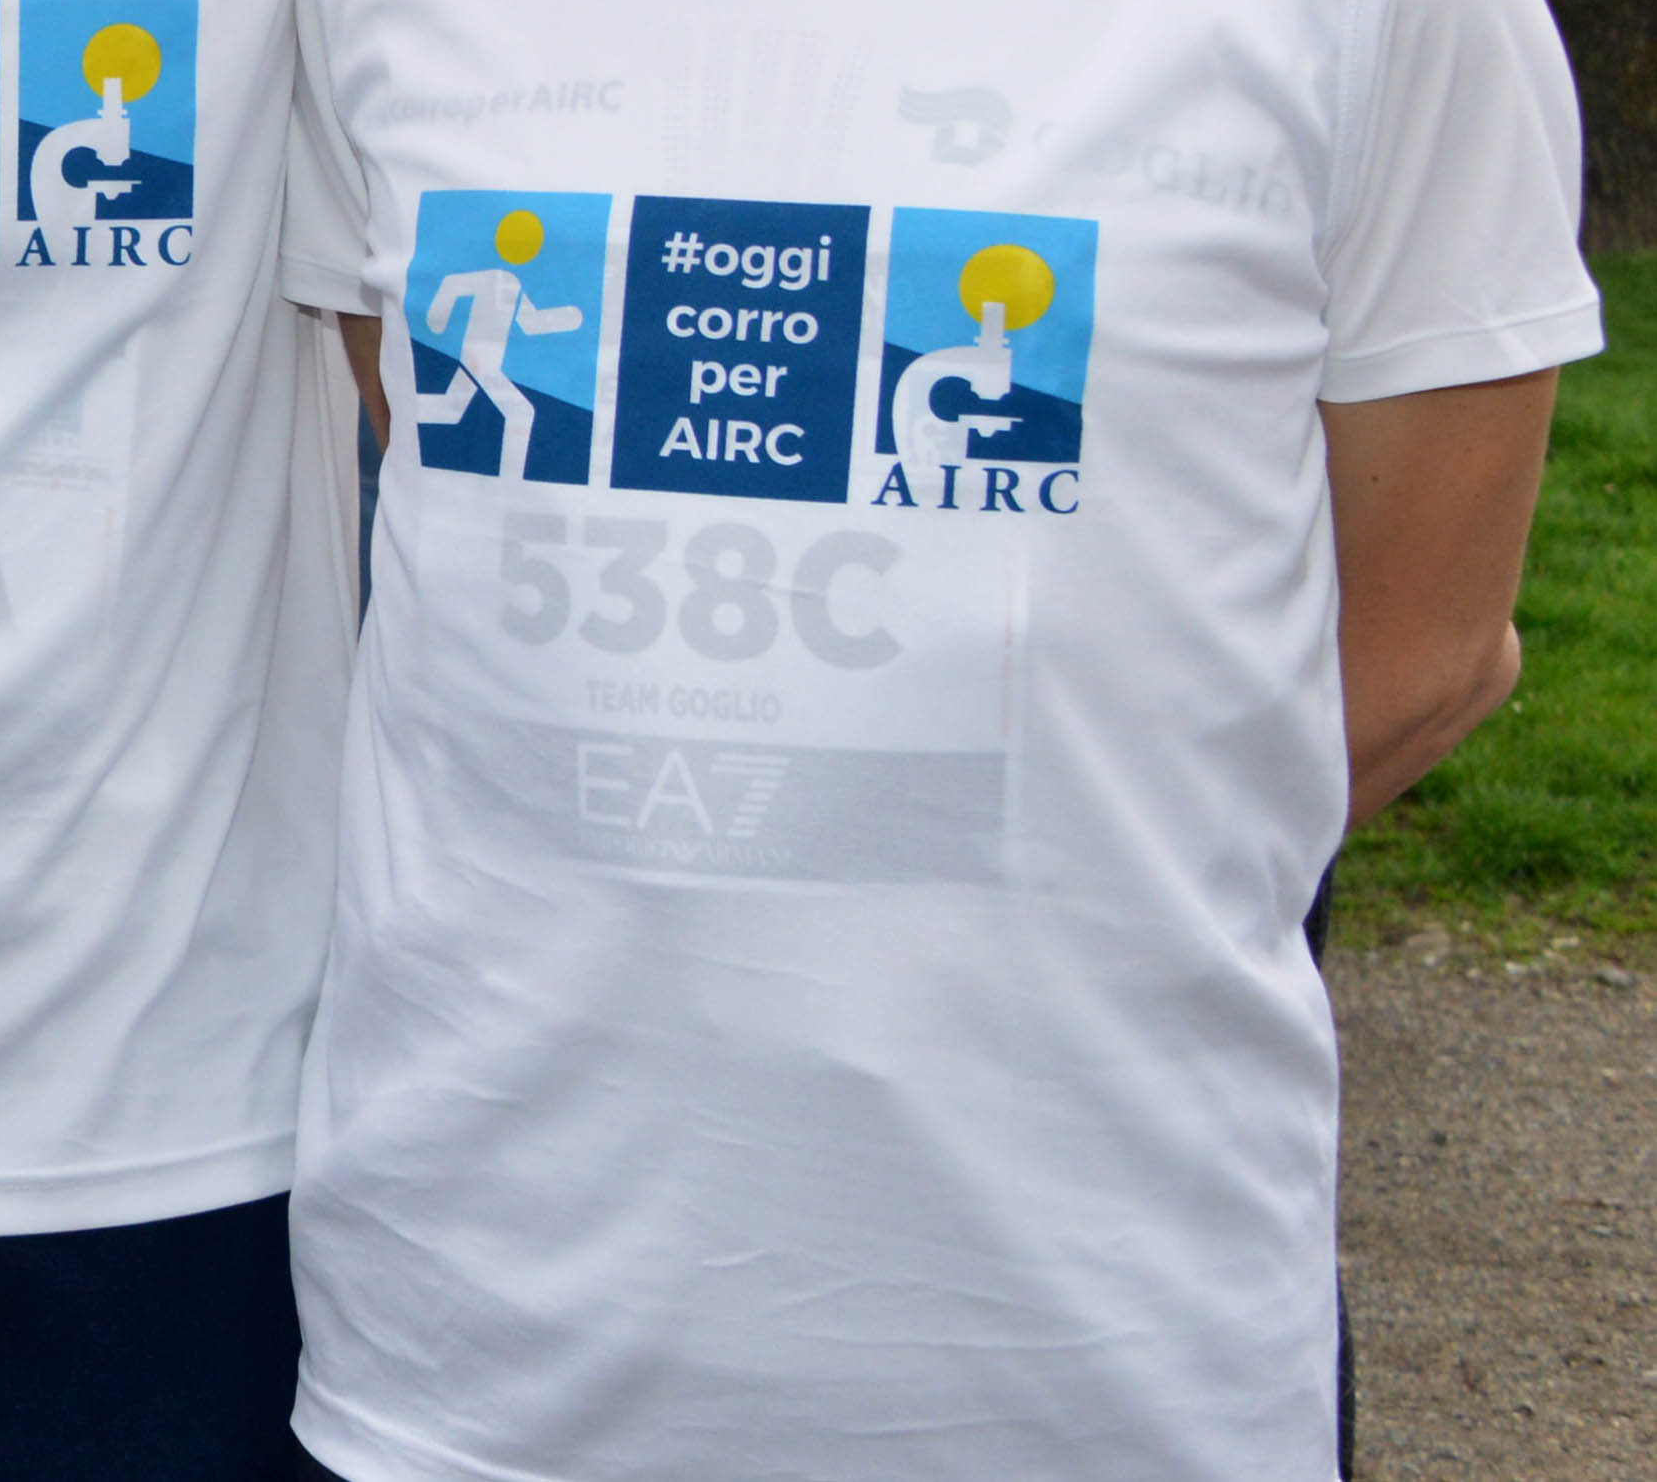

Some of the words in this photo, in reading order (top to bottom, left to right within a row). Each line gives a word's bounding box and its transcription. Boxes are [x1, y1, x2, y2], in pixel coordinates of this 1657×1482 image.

[16, 224, 194, 267] AIRC
[661, 231, 831, 291] #oggi
[666, 304, 819, 345] corro
[689, 359, 788, 405] per
[659, 416, 805, 467] AIRC
[872, 463, 1081, 514] AIRC
[499, 512, 904, 670] 538C
[585, 678, 660, 717] TEAM
[667, 685, 782, 724] GOGLIO
